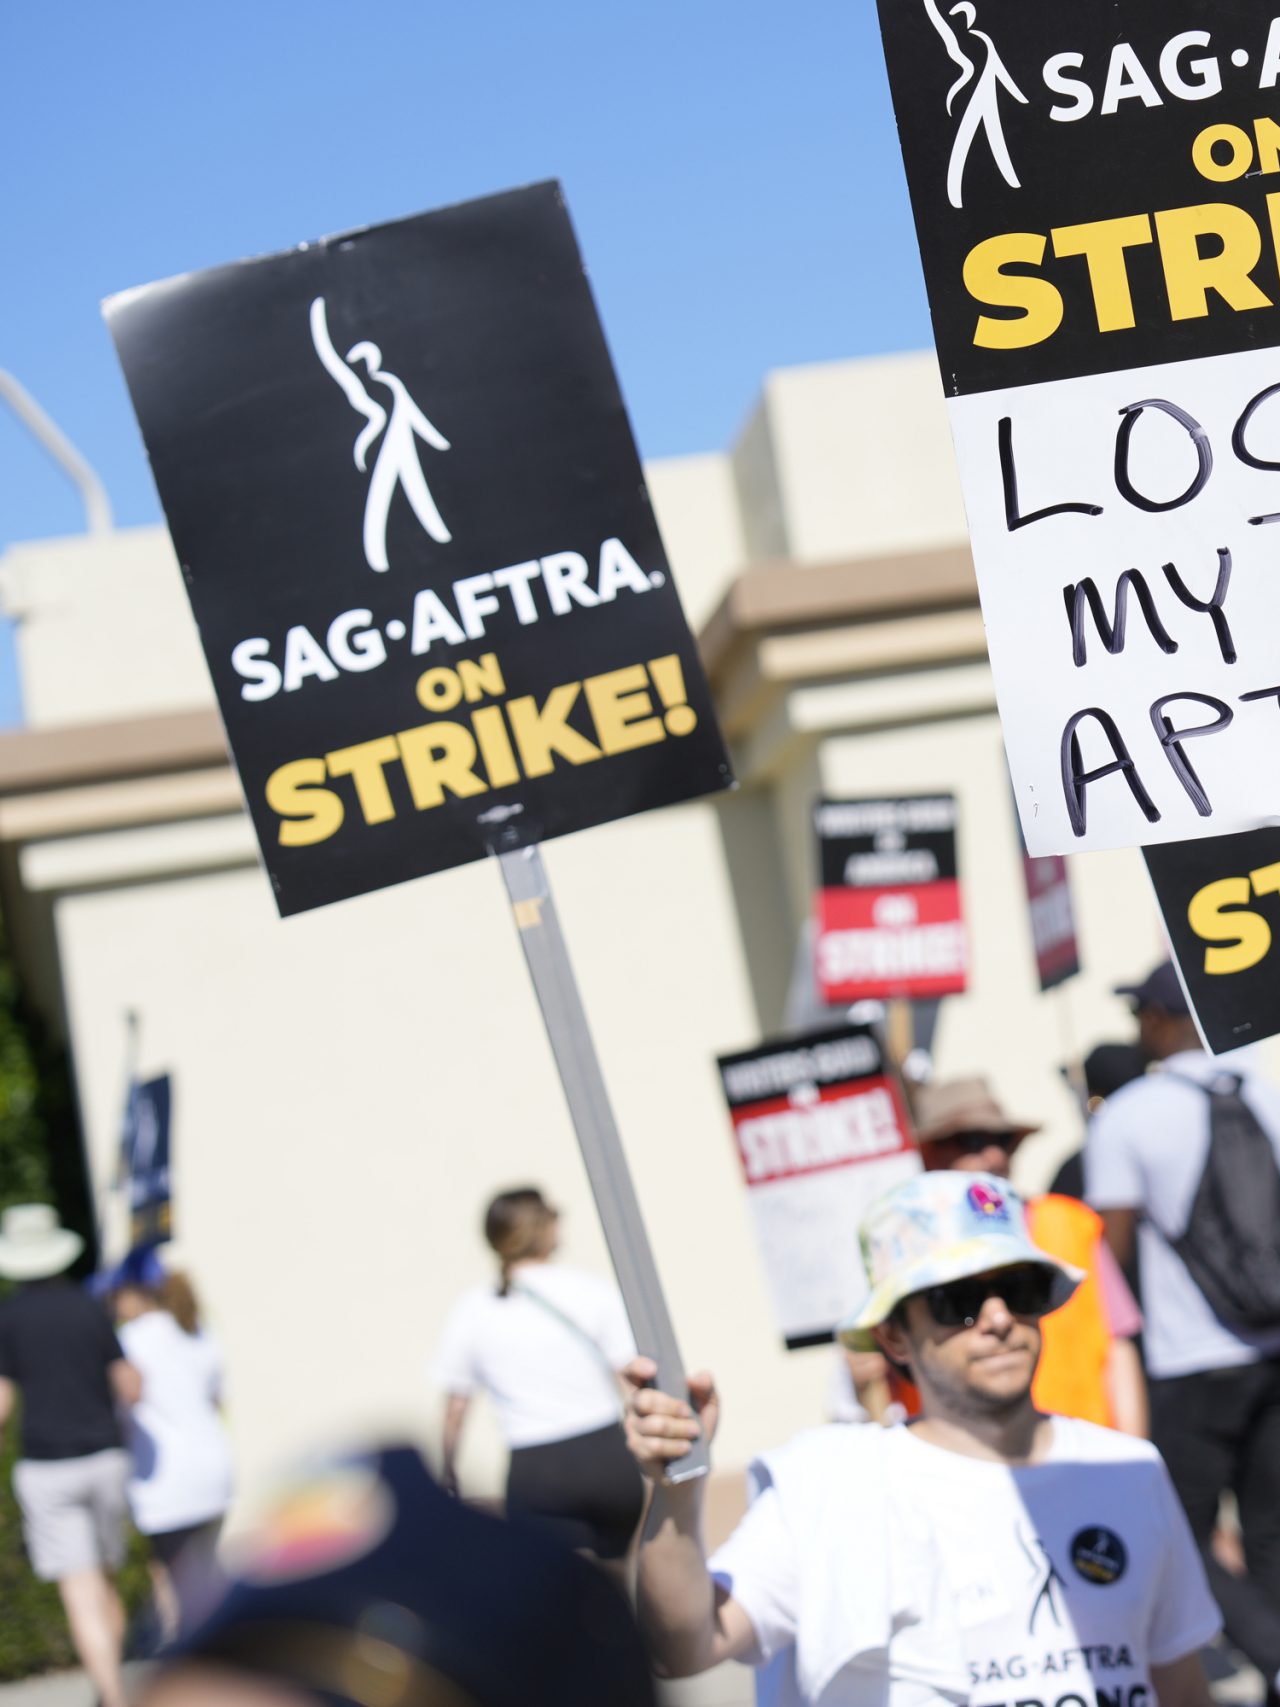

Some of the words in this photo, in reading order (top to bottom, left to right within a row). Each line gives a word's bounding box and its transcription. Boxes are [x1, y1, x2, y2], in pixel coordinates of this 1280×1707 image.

[1063, 547, 1237, 668] MY
[415, 652, 507, 713] ON
[265, 653, 698, 848] STRIKE!
